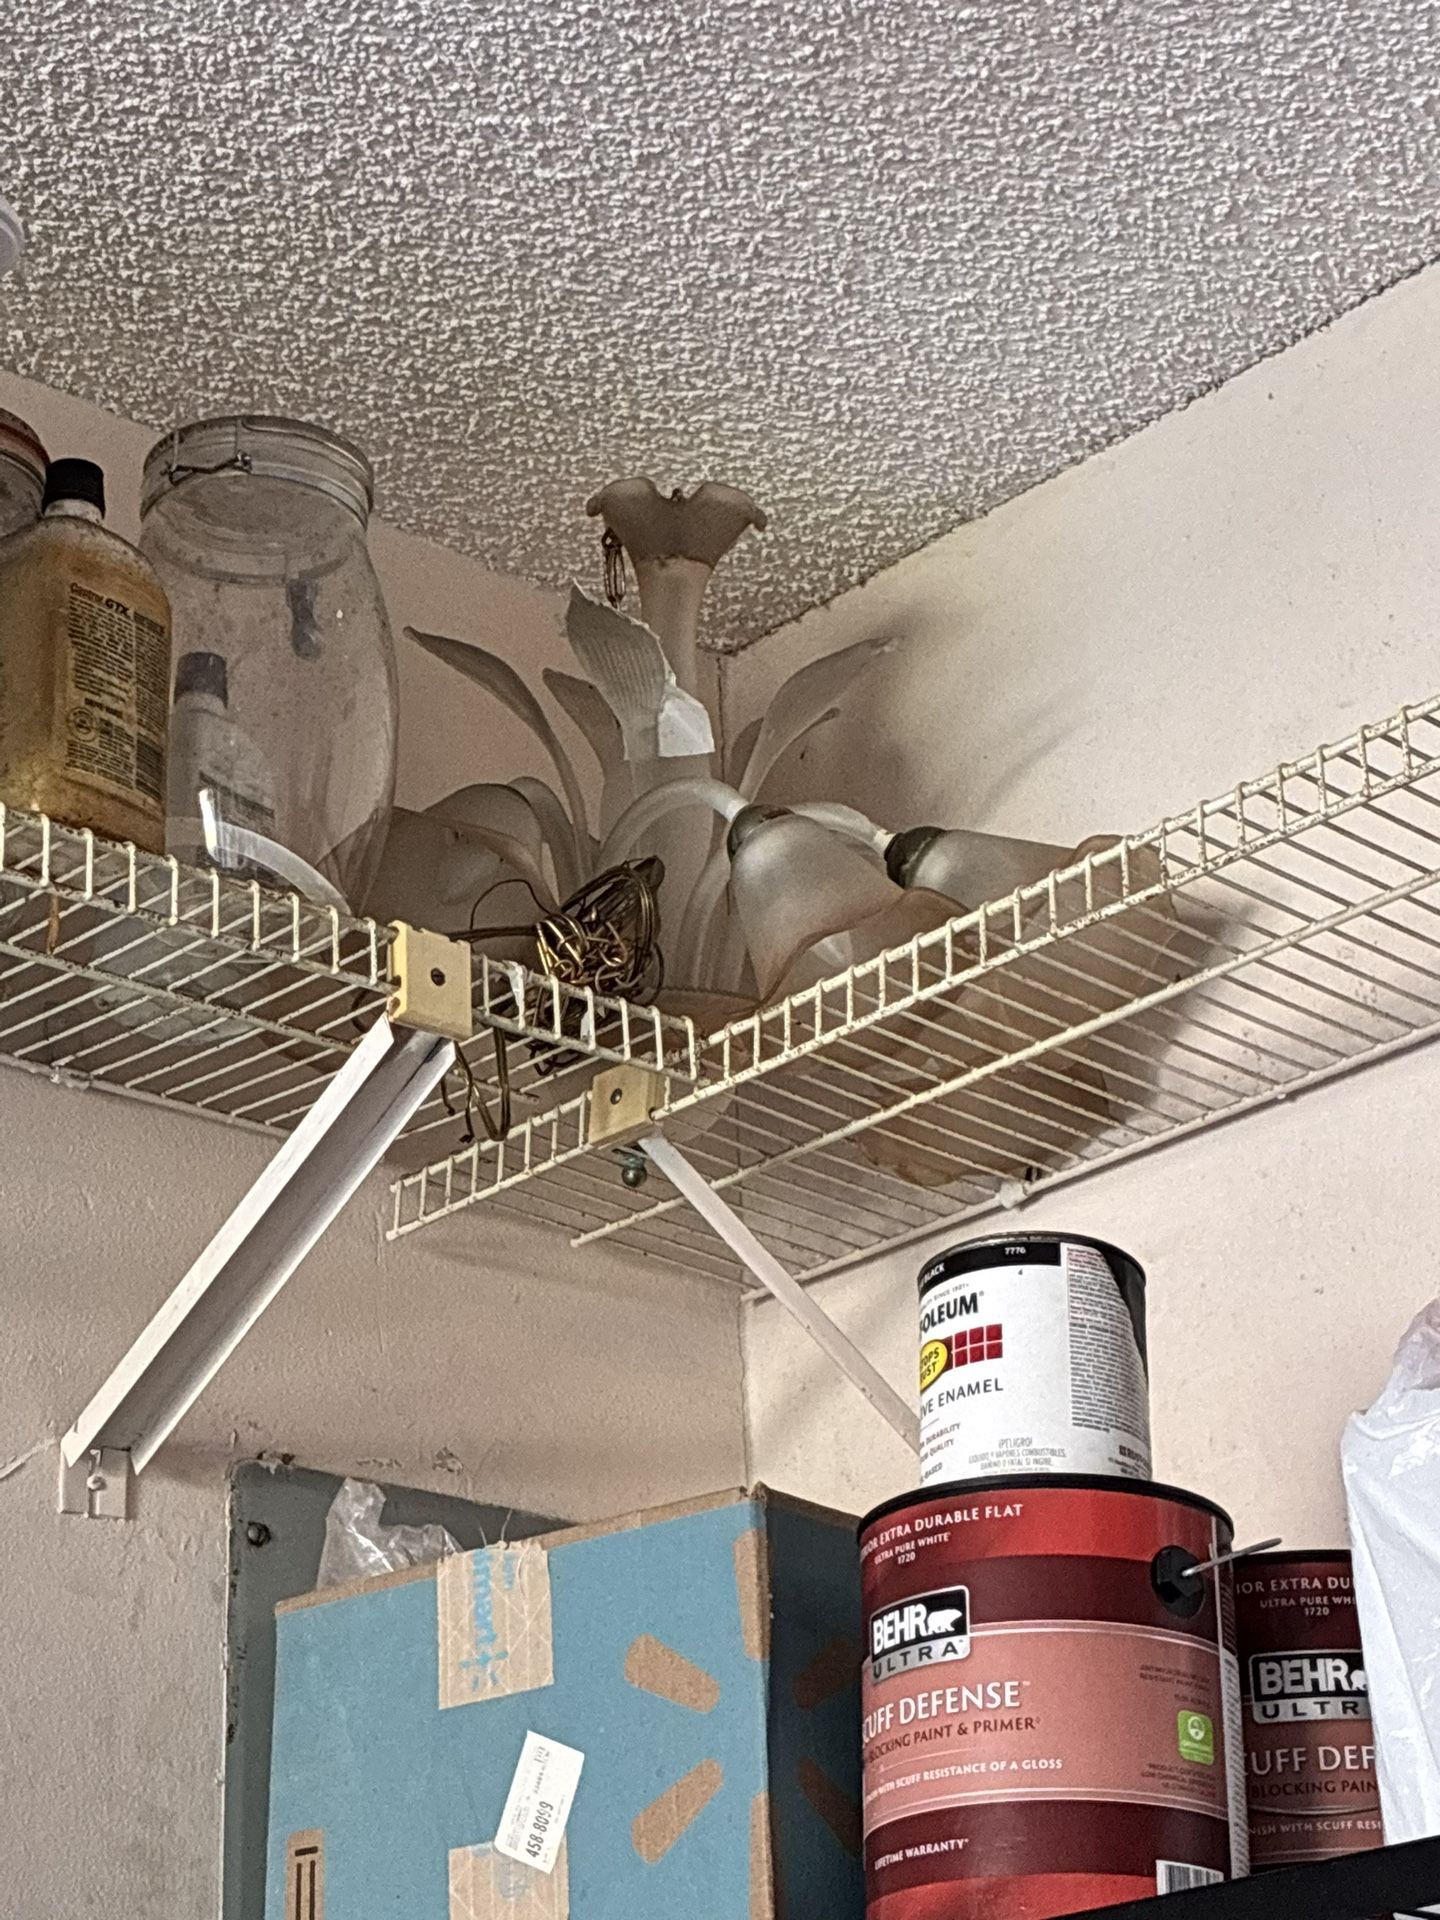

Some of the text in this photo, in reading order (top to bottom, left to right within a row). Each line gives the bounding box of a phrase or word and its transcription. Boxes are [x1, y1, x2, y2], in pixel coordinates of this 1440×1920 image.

[105, 598, 130, 618] GTX
[1005, 1246, 1026, 1255] 7776
[924, 1262, 945, 1284] BLACK
[920, 1292, 978, 1333] OLEUM
[920, 1347, 939, 1369] TOPS
[938, 1378, 1004, 1407] ENAMEL
[879, 1524, 911, 1545] EXTRA
[914, 1507, 980, 1532] DURABLE
[985, 1503, 1024, 1518] FLAT
[874, 1532, 949, 1565] ULTRA PURE WHITE
[897, 1551, 916, 1565] 1720
[1270, 1577, 1322, 1591] EXTRA
[1260, 1597, 1296, 1608] ULTRA
[1300, 1596, 1329, 1605] PURE
[1304, 1607, 1329, 1616] 1720
[873, 1603, 927, 1655] BEHR
[872, 1640, 959, 1679] ULTRA
[1258, 1658, 1352, 1695] BEHR
[863, 1681, 1021, 1744] CUFF DEFENSE
[1262, 1701, 1359, 1719] ULTR
[914, 1724, 952, 1744] PAINT
[957, 1722, 968, 1736] &
[973, 1717, 1036, 1734] PRIMER
[896, 1772, 921, 1788] SCUFF
[923, 1762, 987, 1781] RESISTANCE
[989, 1760, 1006, 1771] OF
[1009, 1760, 1018, 1770] A
[1022, 1758, 1063, 1770] GLOSS
[1245, 1747, 1307, 1776] UFF
[1252, 1781, 1336, 1798] BLOCKING
[525, 1801, 554, 1857] 458-8099
[1280, 1821, 1313, 1832] WITH
[1316, 1820, 1353, 1831] SCUFF
[905, 1839, 965, 1858] WARRANTY
